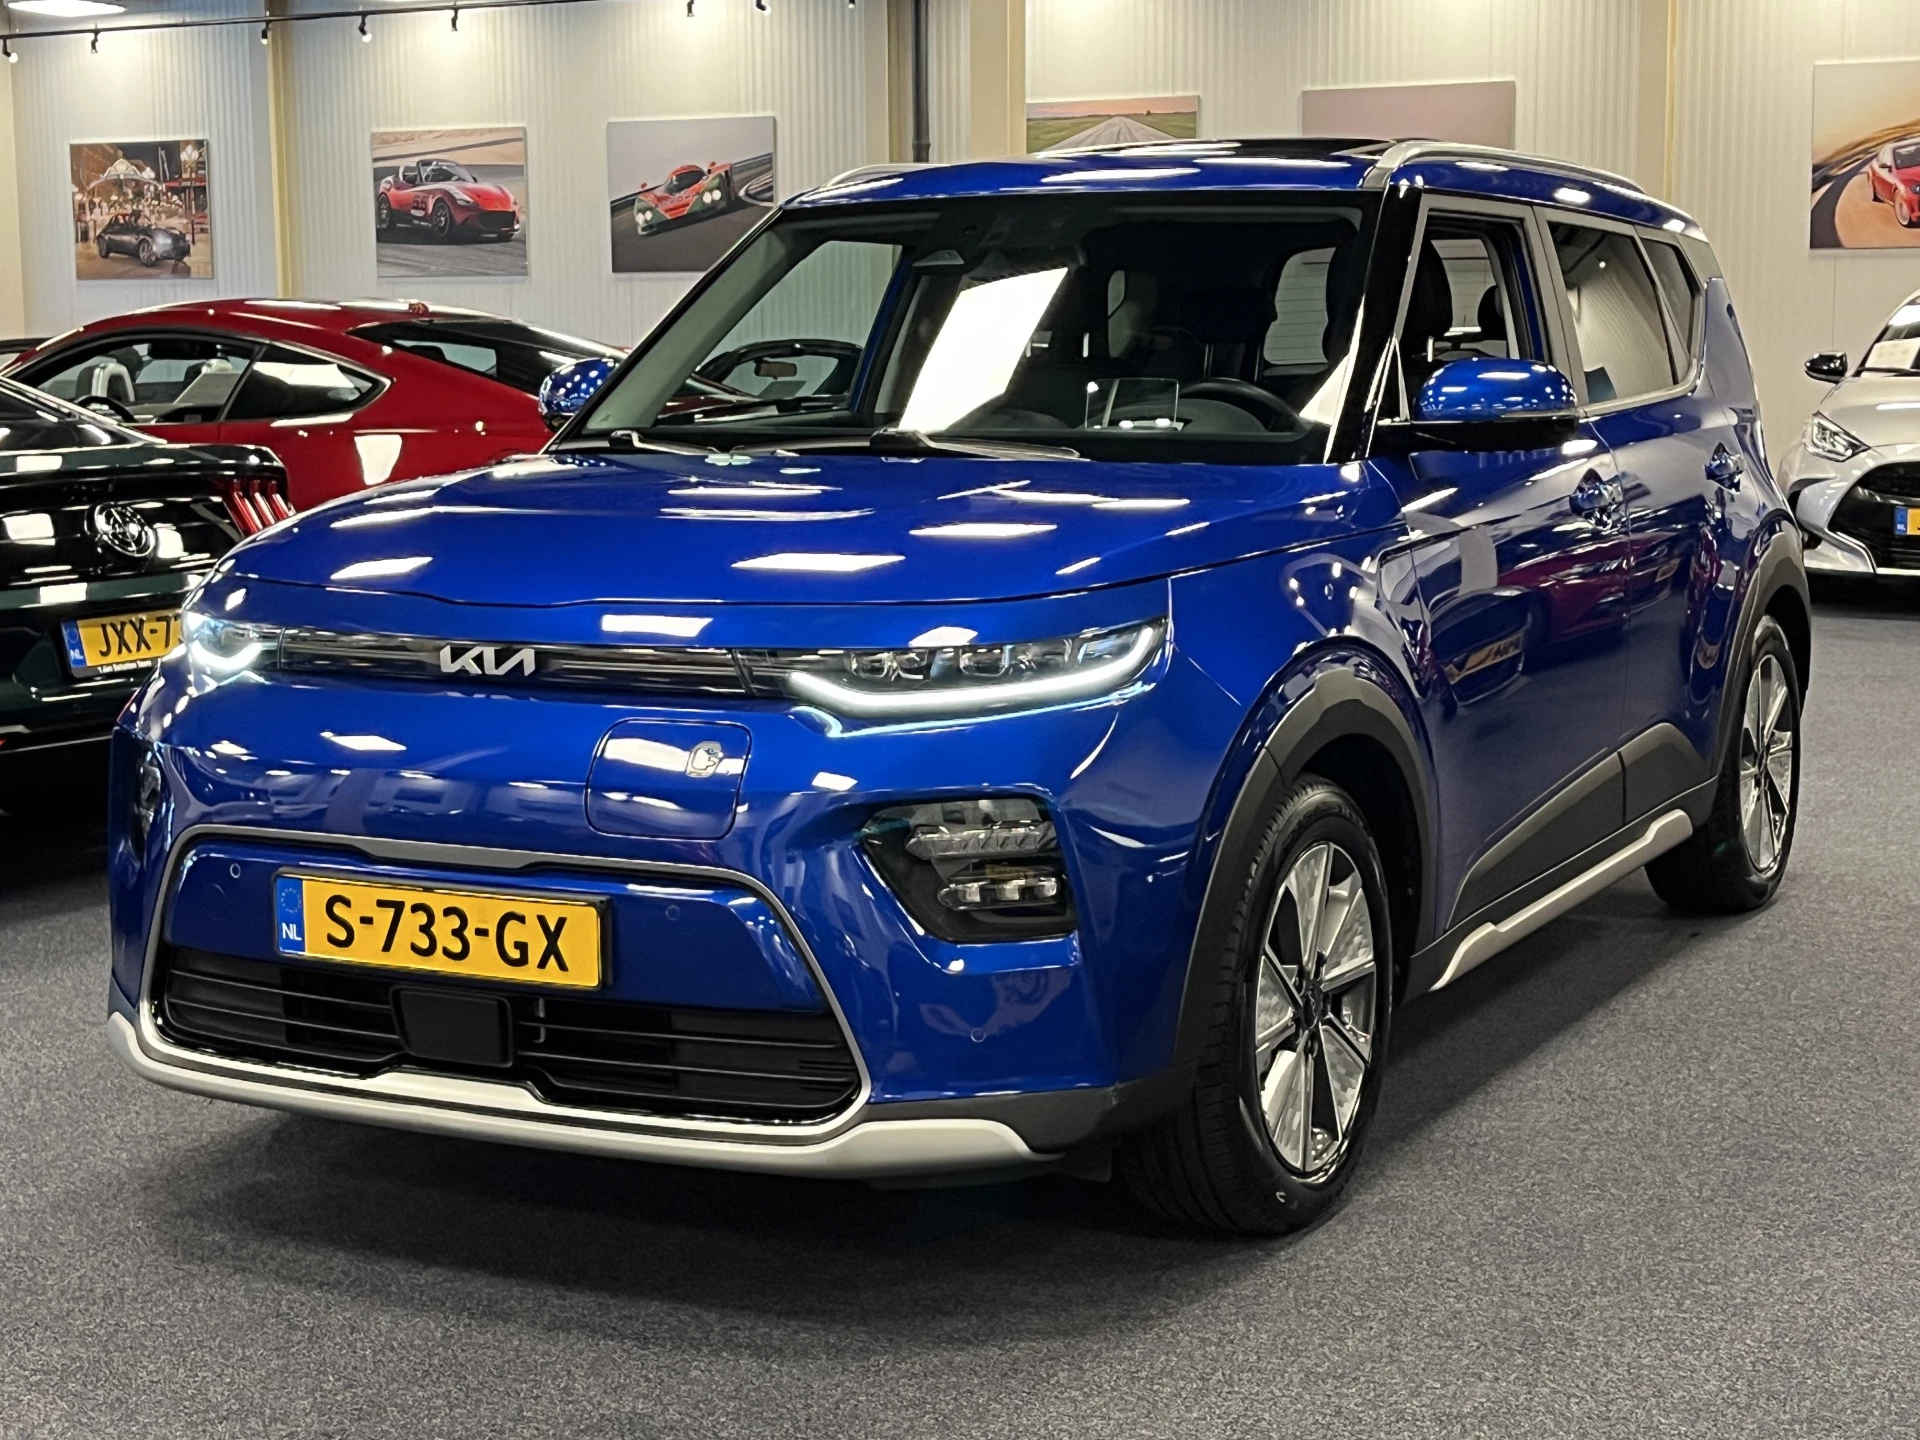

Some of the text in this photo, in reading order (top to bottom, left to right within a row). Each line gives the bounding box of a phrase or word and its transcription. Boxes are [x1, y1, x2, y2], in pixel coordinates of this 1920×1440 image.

[69, 648, 84, 660] NL
[440, 645, 536, 677] KIA
[282, 922, 302, 941] NL
[325, 895, 569, 972] S-733-GX
